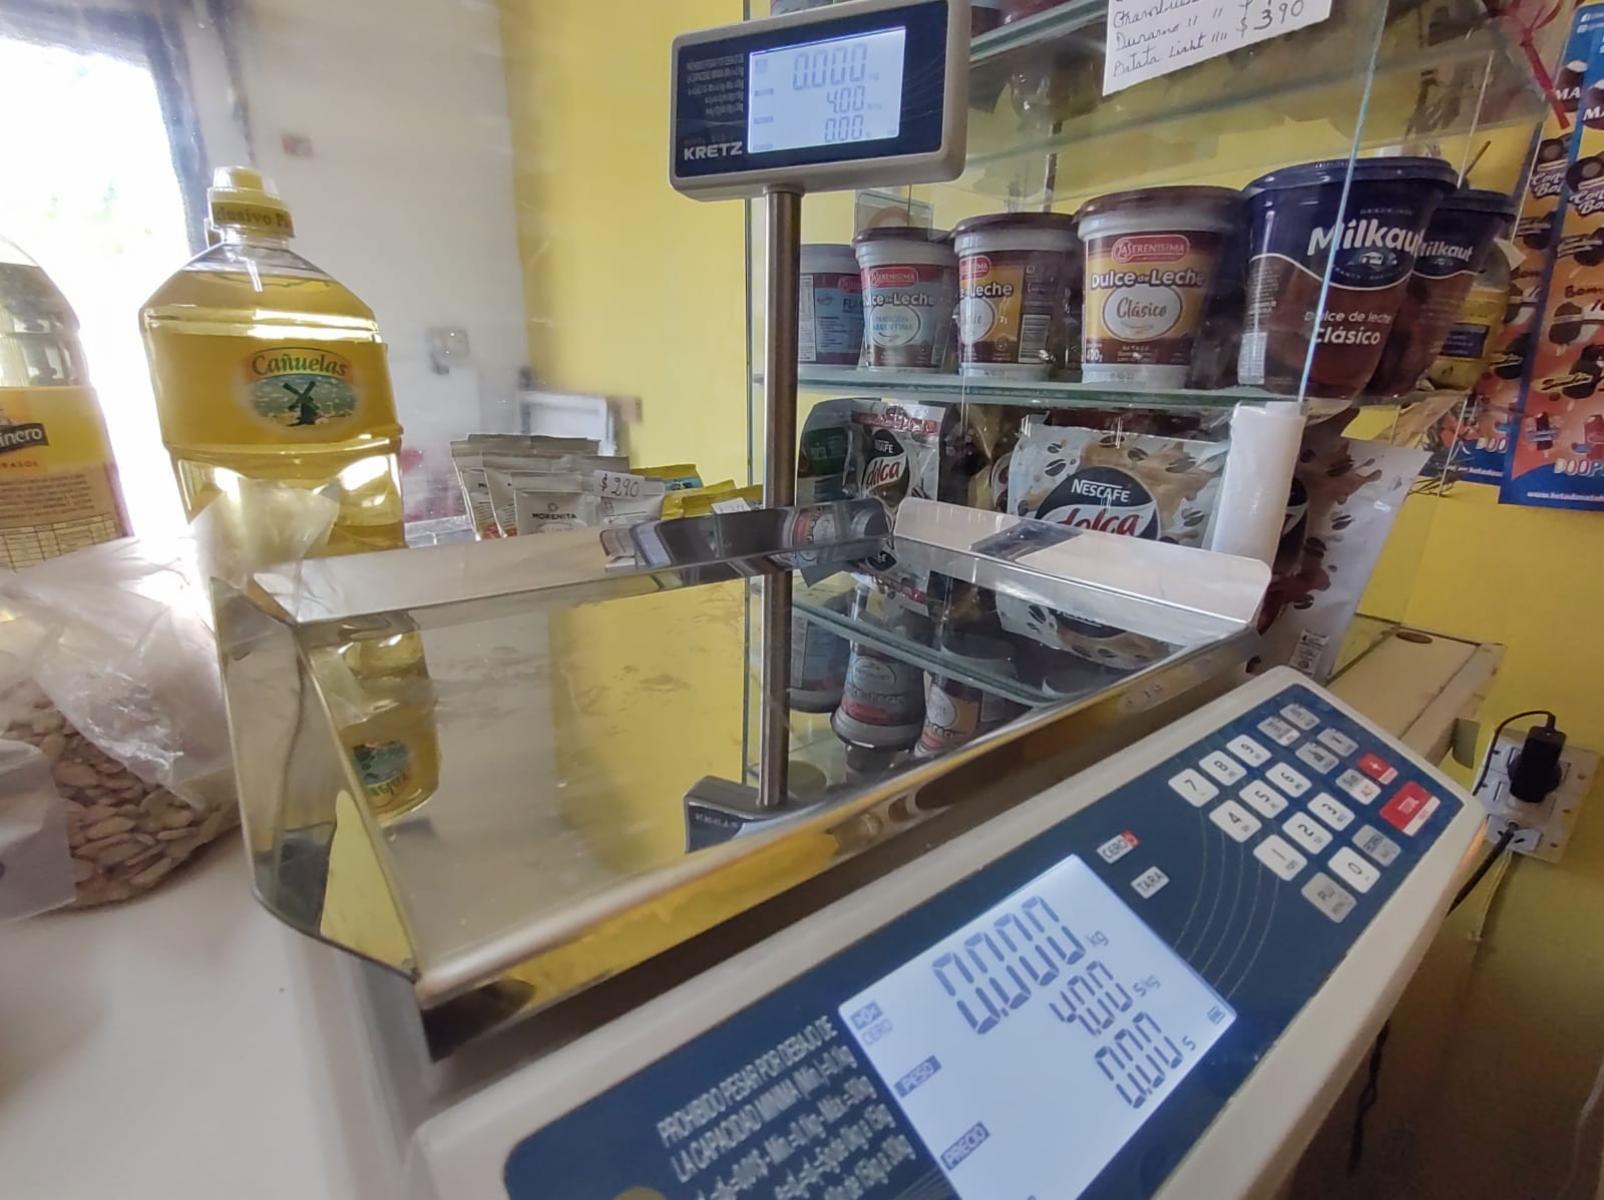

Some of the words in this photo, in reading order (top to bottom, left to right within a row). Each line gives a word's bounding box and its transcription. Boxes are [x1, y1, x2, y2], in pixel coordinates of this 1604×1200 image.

[684, 141, 743, 160] KRETZ
[1091, 270, 1137, 290] Dulce
[1151, 269, 1206, 287] Leche
[1116, 297, 1168, 319] Clásico
[1304, 311, 1346, 323] Dlce
[1348, 311, 1366, 322] de
[1314, 326, 1382, 345] Clásico
[251, 354, 349, 377] Cañuelas
[864, 458, 901, 490] dlca
[532, 512, 577, 520] MORENITA
[1136, 870, 1165, 894] TARA
[931, 895, 1087, 1036] 0.000
[657, 1086, 728, 1147] PROHIBIDO
[719, 1064, 763, 1102] PESAR
[754, 1049, 784, 1080] POR
[777, 1024, 824, 1067] DEBAJO
[670, 1153, 697, 1183] LA
[689, 1103, 764, 1170] CAPACIDAD
